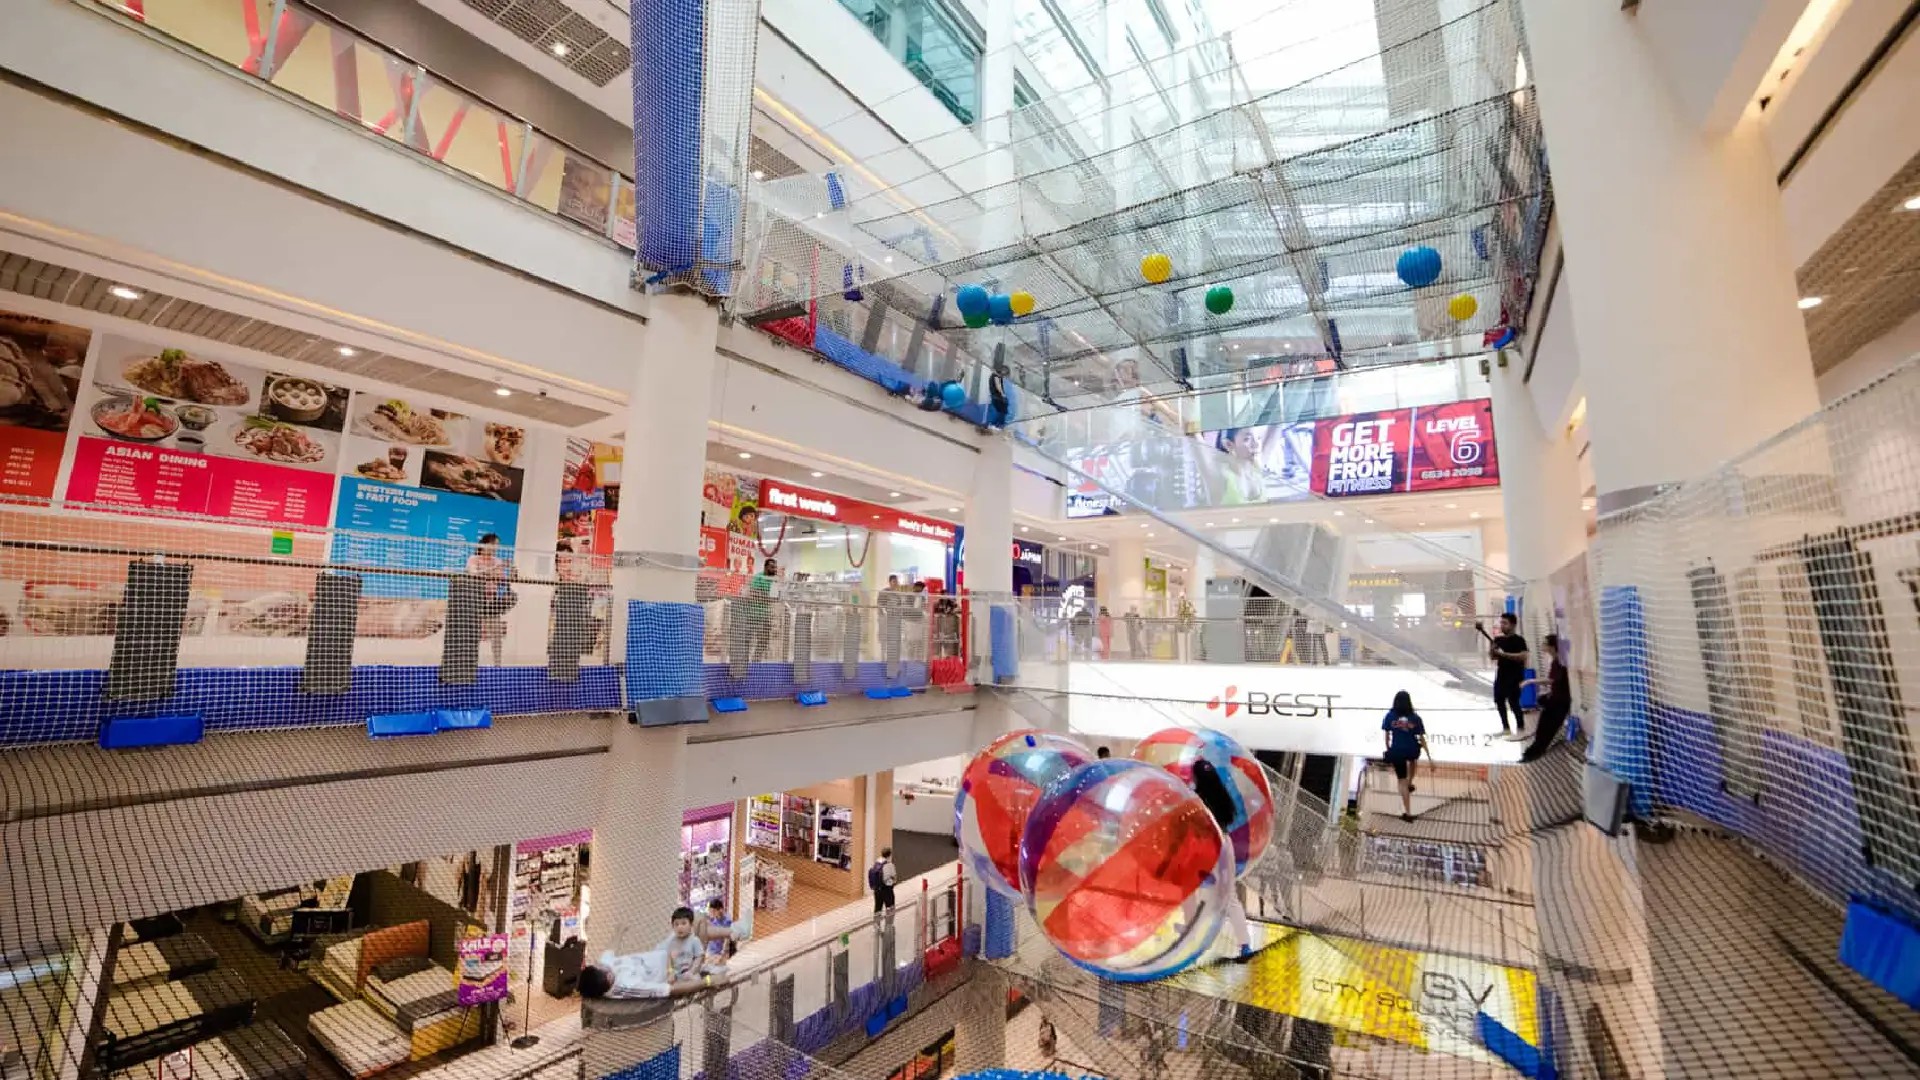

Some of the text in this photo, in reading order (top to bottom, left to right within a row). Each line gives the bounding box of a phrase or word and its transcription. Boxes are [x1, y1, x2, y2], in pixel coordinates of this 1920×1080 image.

[1331, 419, 1396, 447] GET
[1426, 416, 1479, 433] LEVEL
[105, 446, 208, 468] ASIAN DINING
[1329, 442, 1394, 464] MORE
[1450, 429, 1482, 464] 6
[1328, 459, 1393, 481] FROM
[1327, 475, 1392, 494] FITNESS
[365, 493, 391, 504] FAST
[392, 496, 419, 507] FOOD
[769, 488, 836, 516] first words
[1247, 691, 1342, 718] BEST
[1312, 978, 1367, 999] CITY
